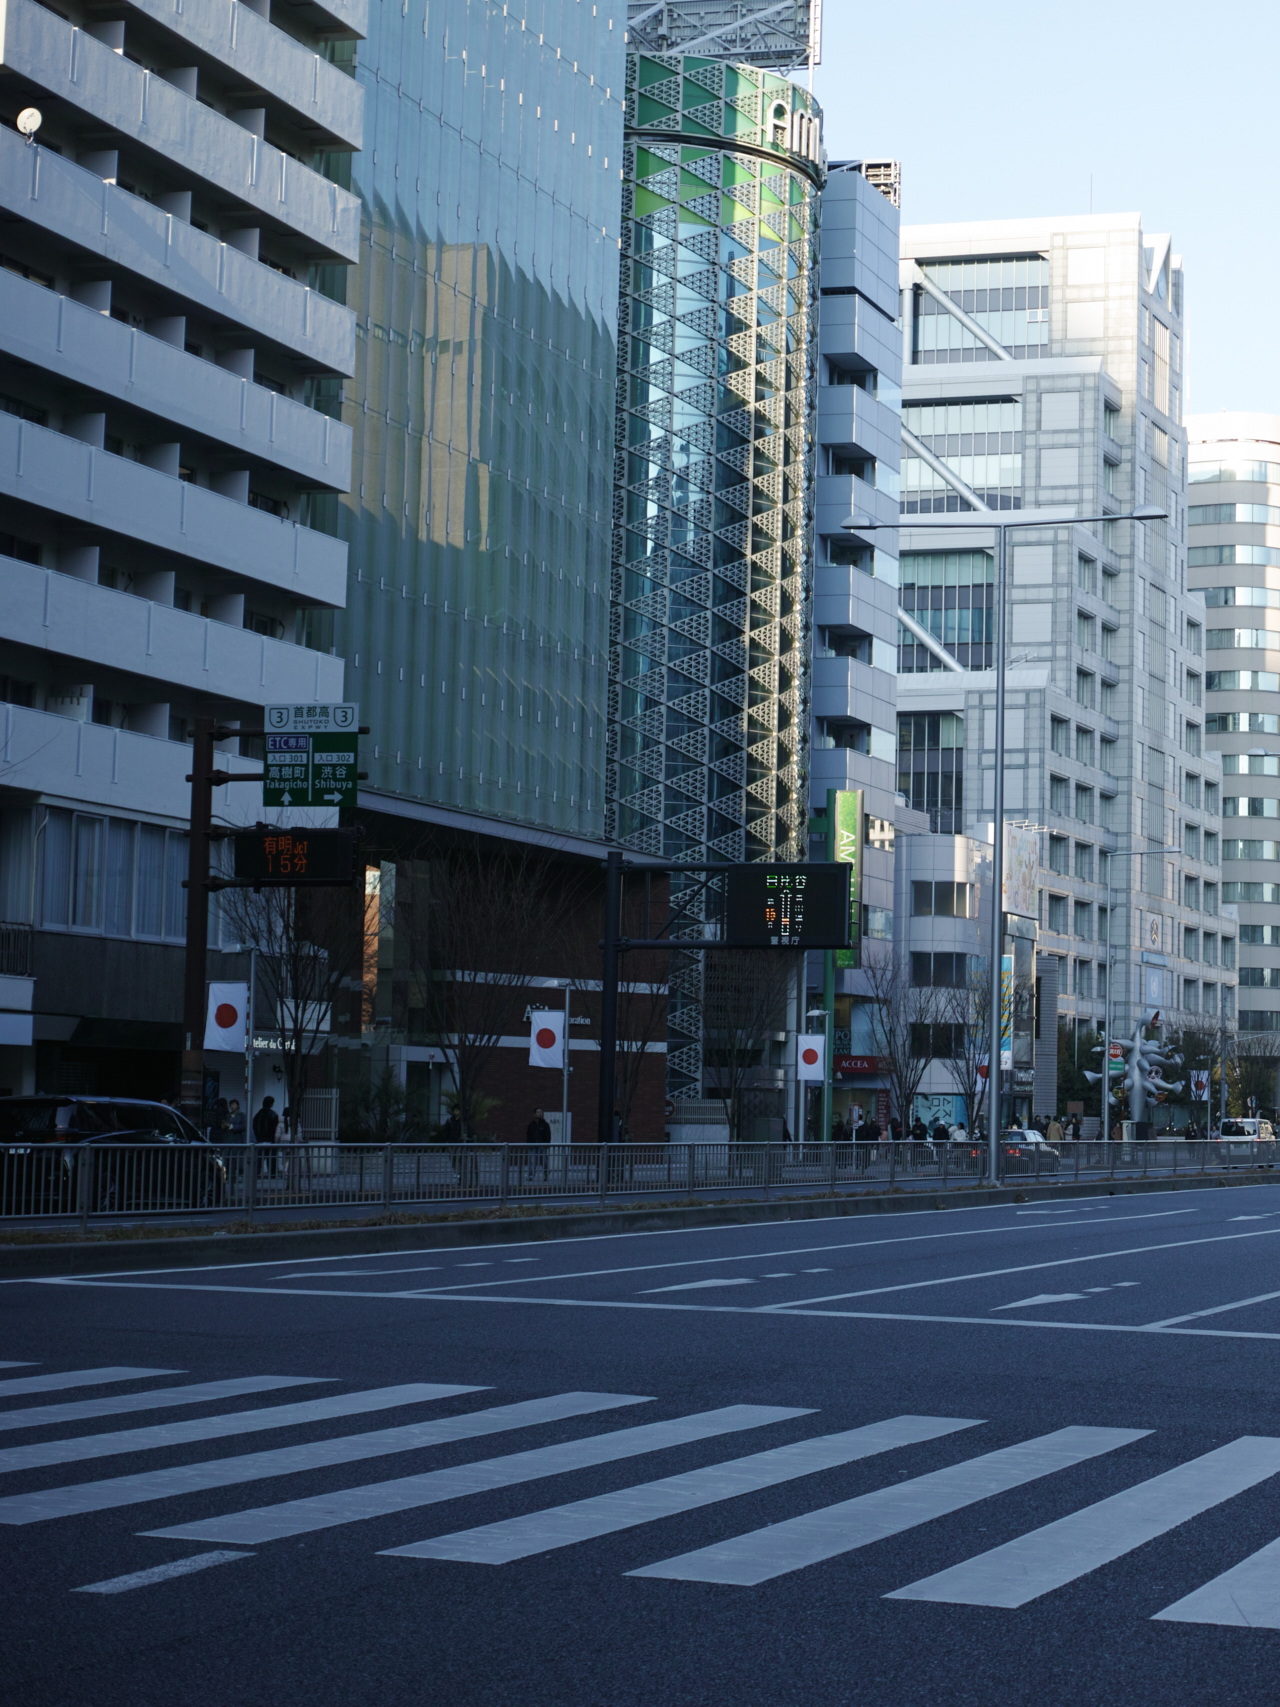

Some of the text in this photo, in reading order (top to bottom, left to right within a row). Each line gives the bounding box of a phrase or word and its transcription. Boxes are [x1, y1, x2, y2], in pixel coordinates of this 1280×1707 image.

[276, 711, 283, 723] 3
[293, 706, 330, 718] 首都高
[341, 711, 348, 723] 3
[268, 737, 308, 750] ETC専用
[270, 754, 304, 763] 入口 301
[317, 754, 351, 763] 入口 302
[268, 766, 306, 779] 高樹町
[321, 766, 347, 778] 渋谷
[266, 779, 308, 790] Takagicho
[314, 779, 353, 790] Shibuya
[267, 855, 308, 873] 15分
[841, 1060, 869, 1069] ACCEA
